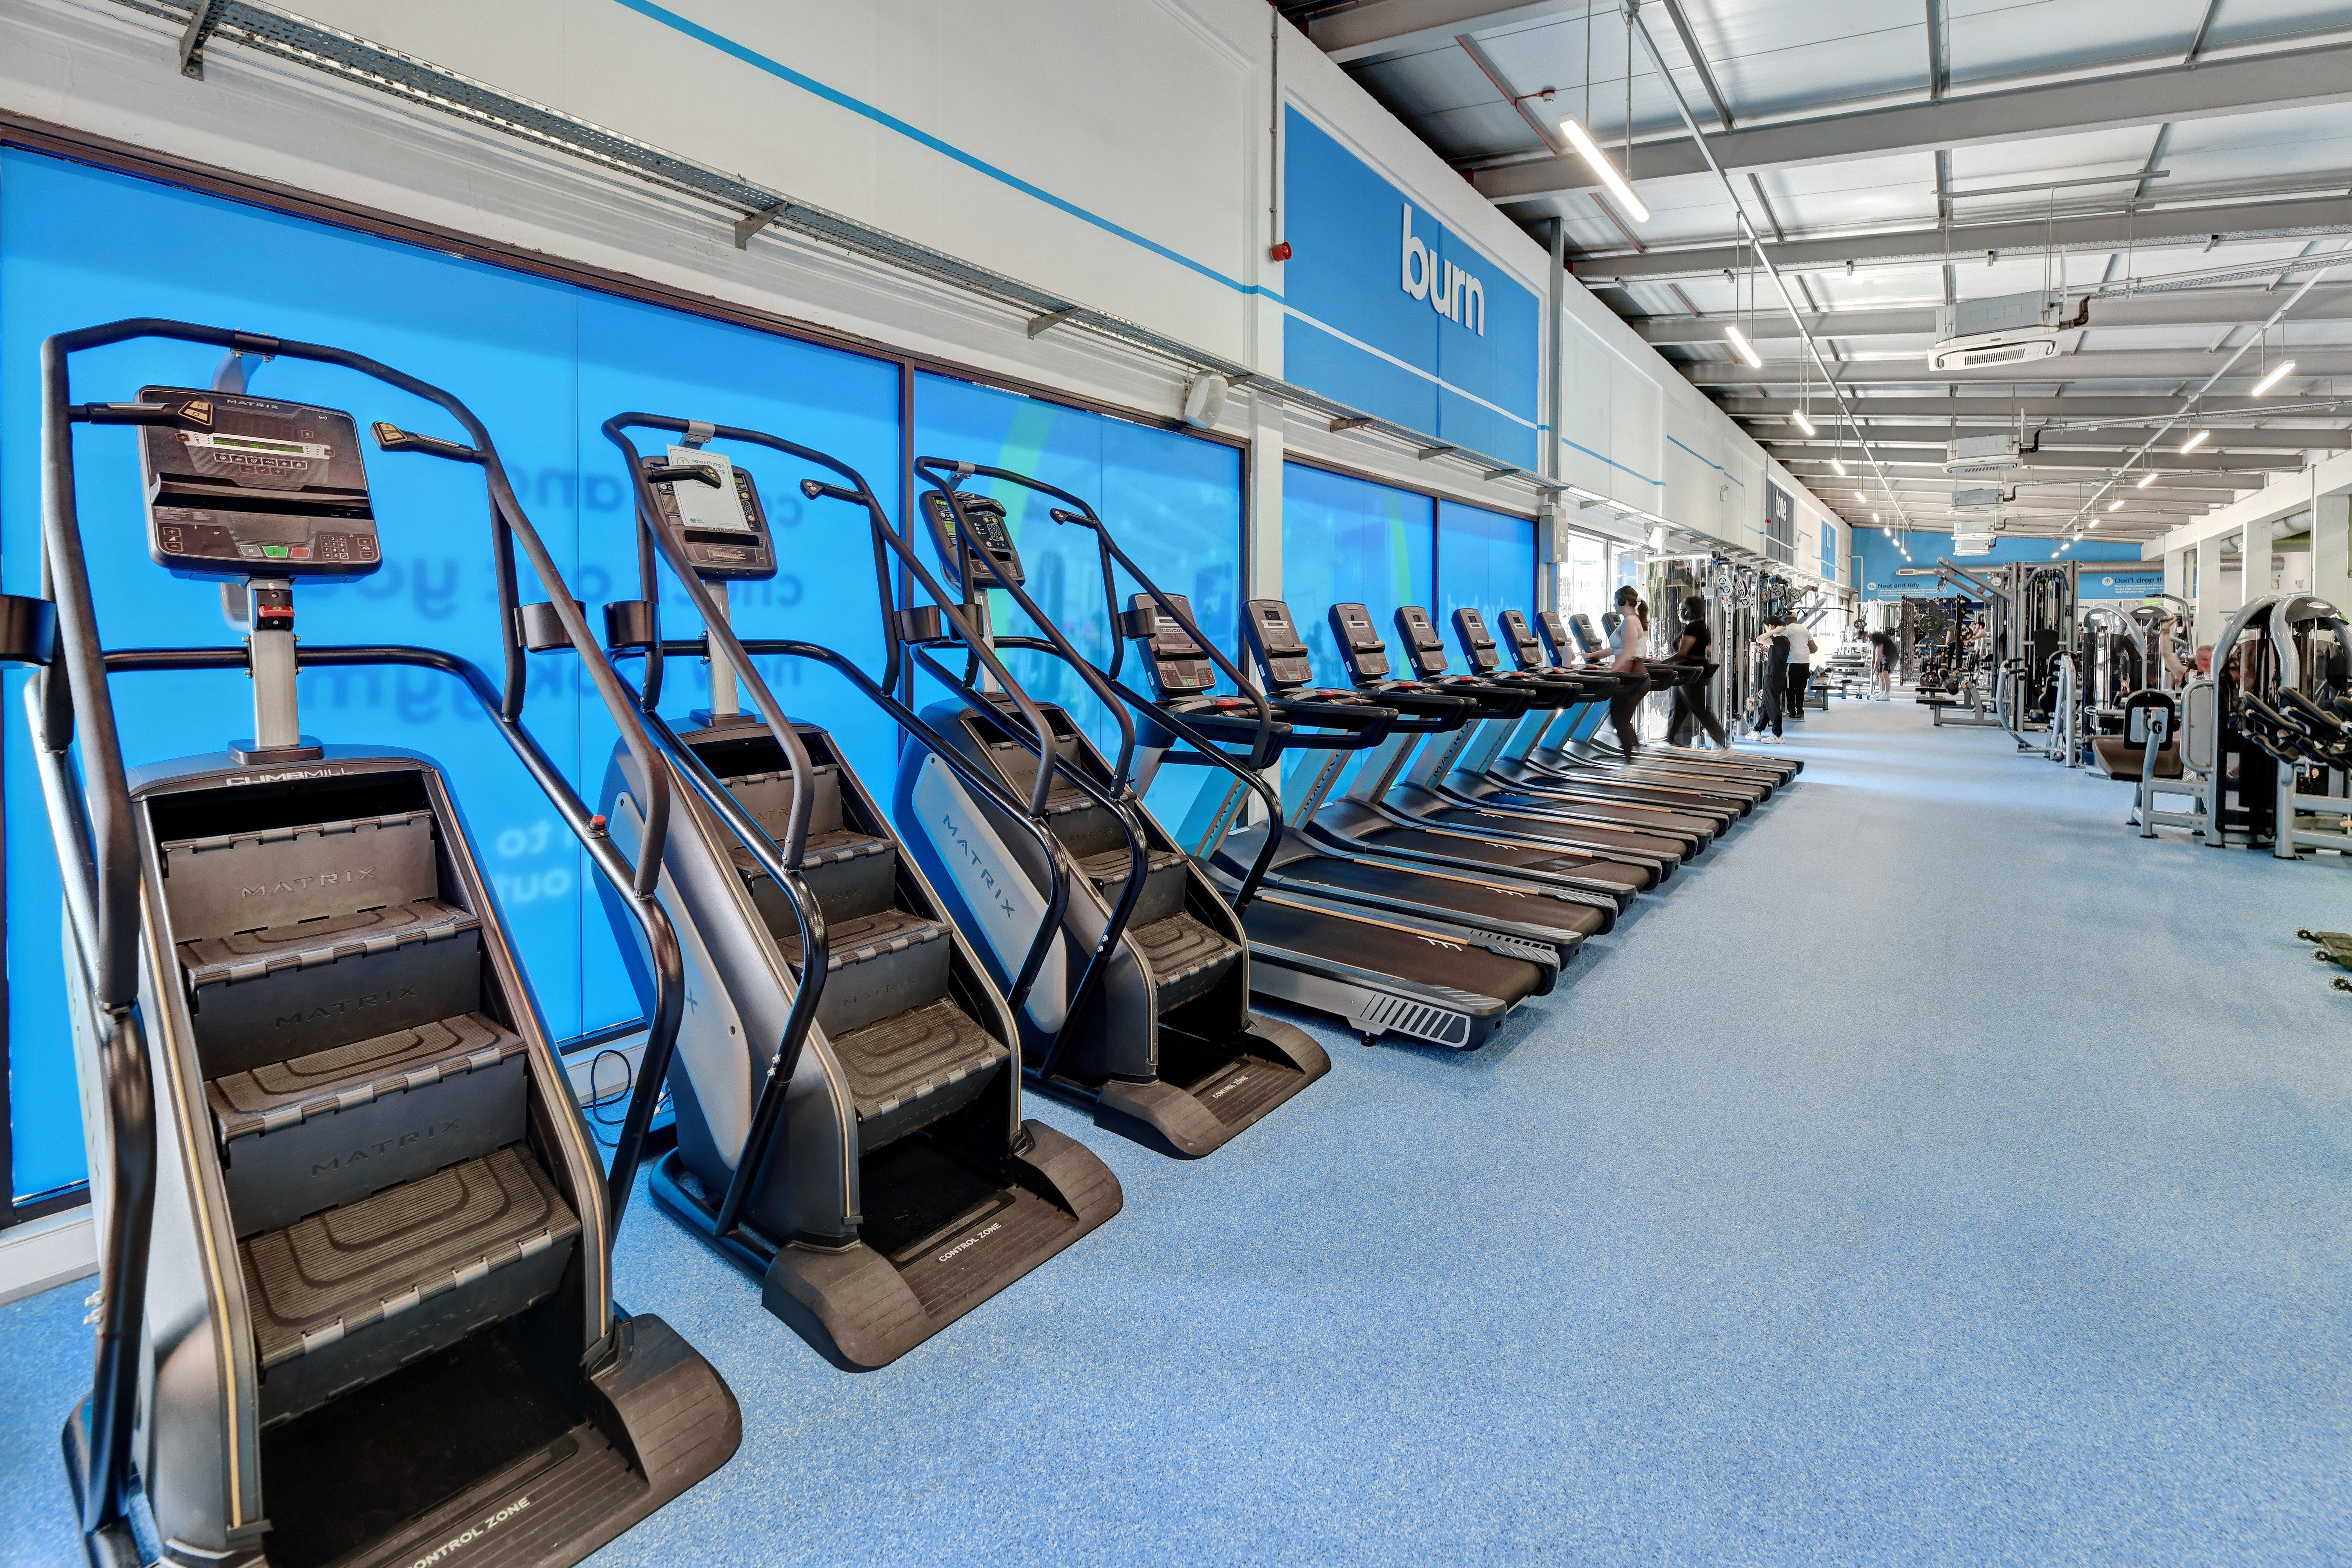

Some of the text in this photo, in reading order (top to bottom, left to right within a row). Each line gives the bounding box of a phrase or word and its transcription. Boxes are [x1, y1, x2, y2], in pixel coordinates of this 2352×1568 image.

[1402, 202, 1484, 337] burn
[226, 399, 279, 410] MATRIX
[692, 459, 725, 468] something's
[1776, 489, 1787, 521] tone
[241, 867, 378, 899] MATRIX
[942, 814, 1016, 920] MATRIX
[275, 985, 418, 1029] MATRIX
[843, 977, 916, 1007] MATRIX
[1212, 1075, 1249, 1098] CONTROL ZONE
[311, 1117, 462, 1178] MATRIX
[939, 1222, 1002, 1262] CONTROL ZONE
[485, 1497, 531, 1529] ZONE
